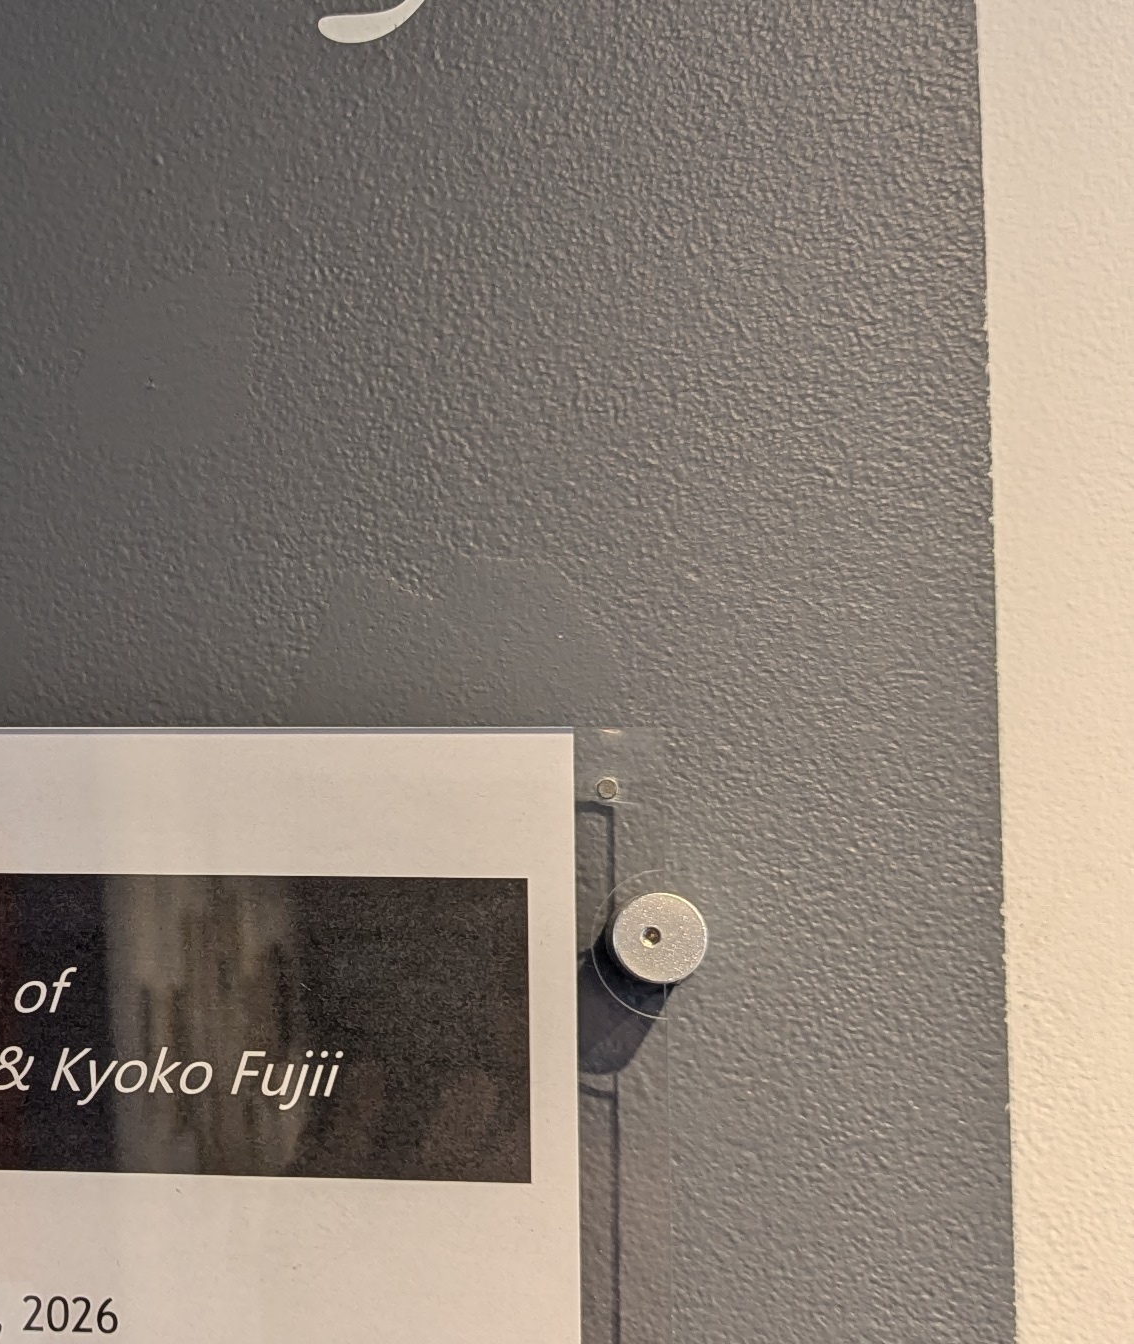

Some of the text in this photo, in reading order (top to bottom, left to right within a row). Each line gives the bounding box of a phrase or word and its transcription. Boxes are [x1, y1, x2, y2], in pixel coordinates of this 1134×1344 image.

[14, 966, 76, 1014] of
[50, 1046, 213, 1106] Kyoko
[230, 1049, 344, 1111] Fujii
[22, 1295, 119, 1334] 2026
